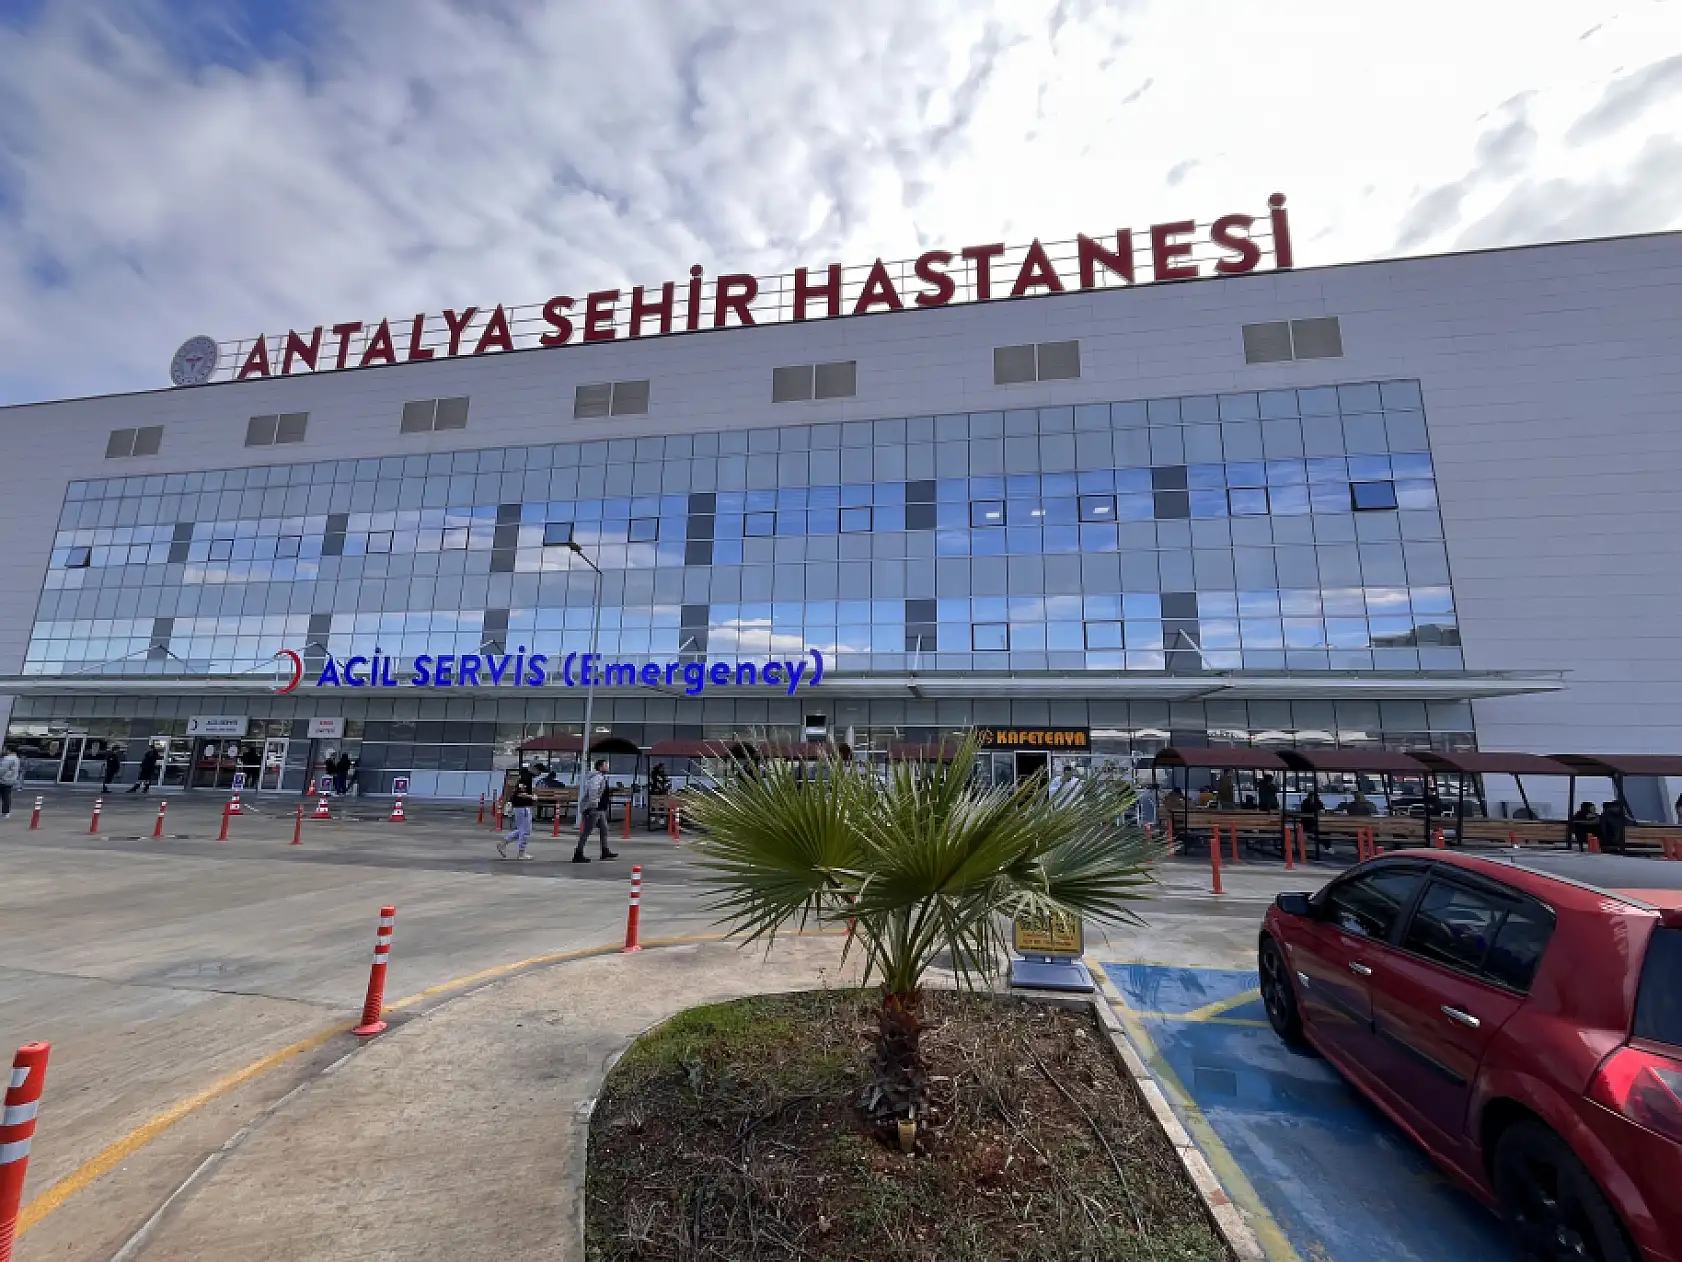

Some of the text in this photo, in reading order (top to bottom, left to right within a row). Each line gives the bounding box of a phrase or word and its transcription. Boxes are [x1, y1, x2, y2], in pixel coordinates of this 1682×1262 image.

[236, 303, 514, 380] ANTALYA
[793, 192, 1294, 320] HASTANESİ
[316, 645, 825, 696] ACİL SERVİS (Emergency)
